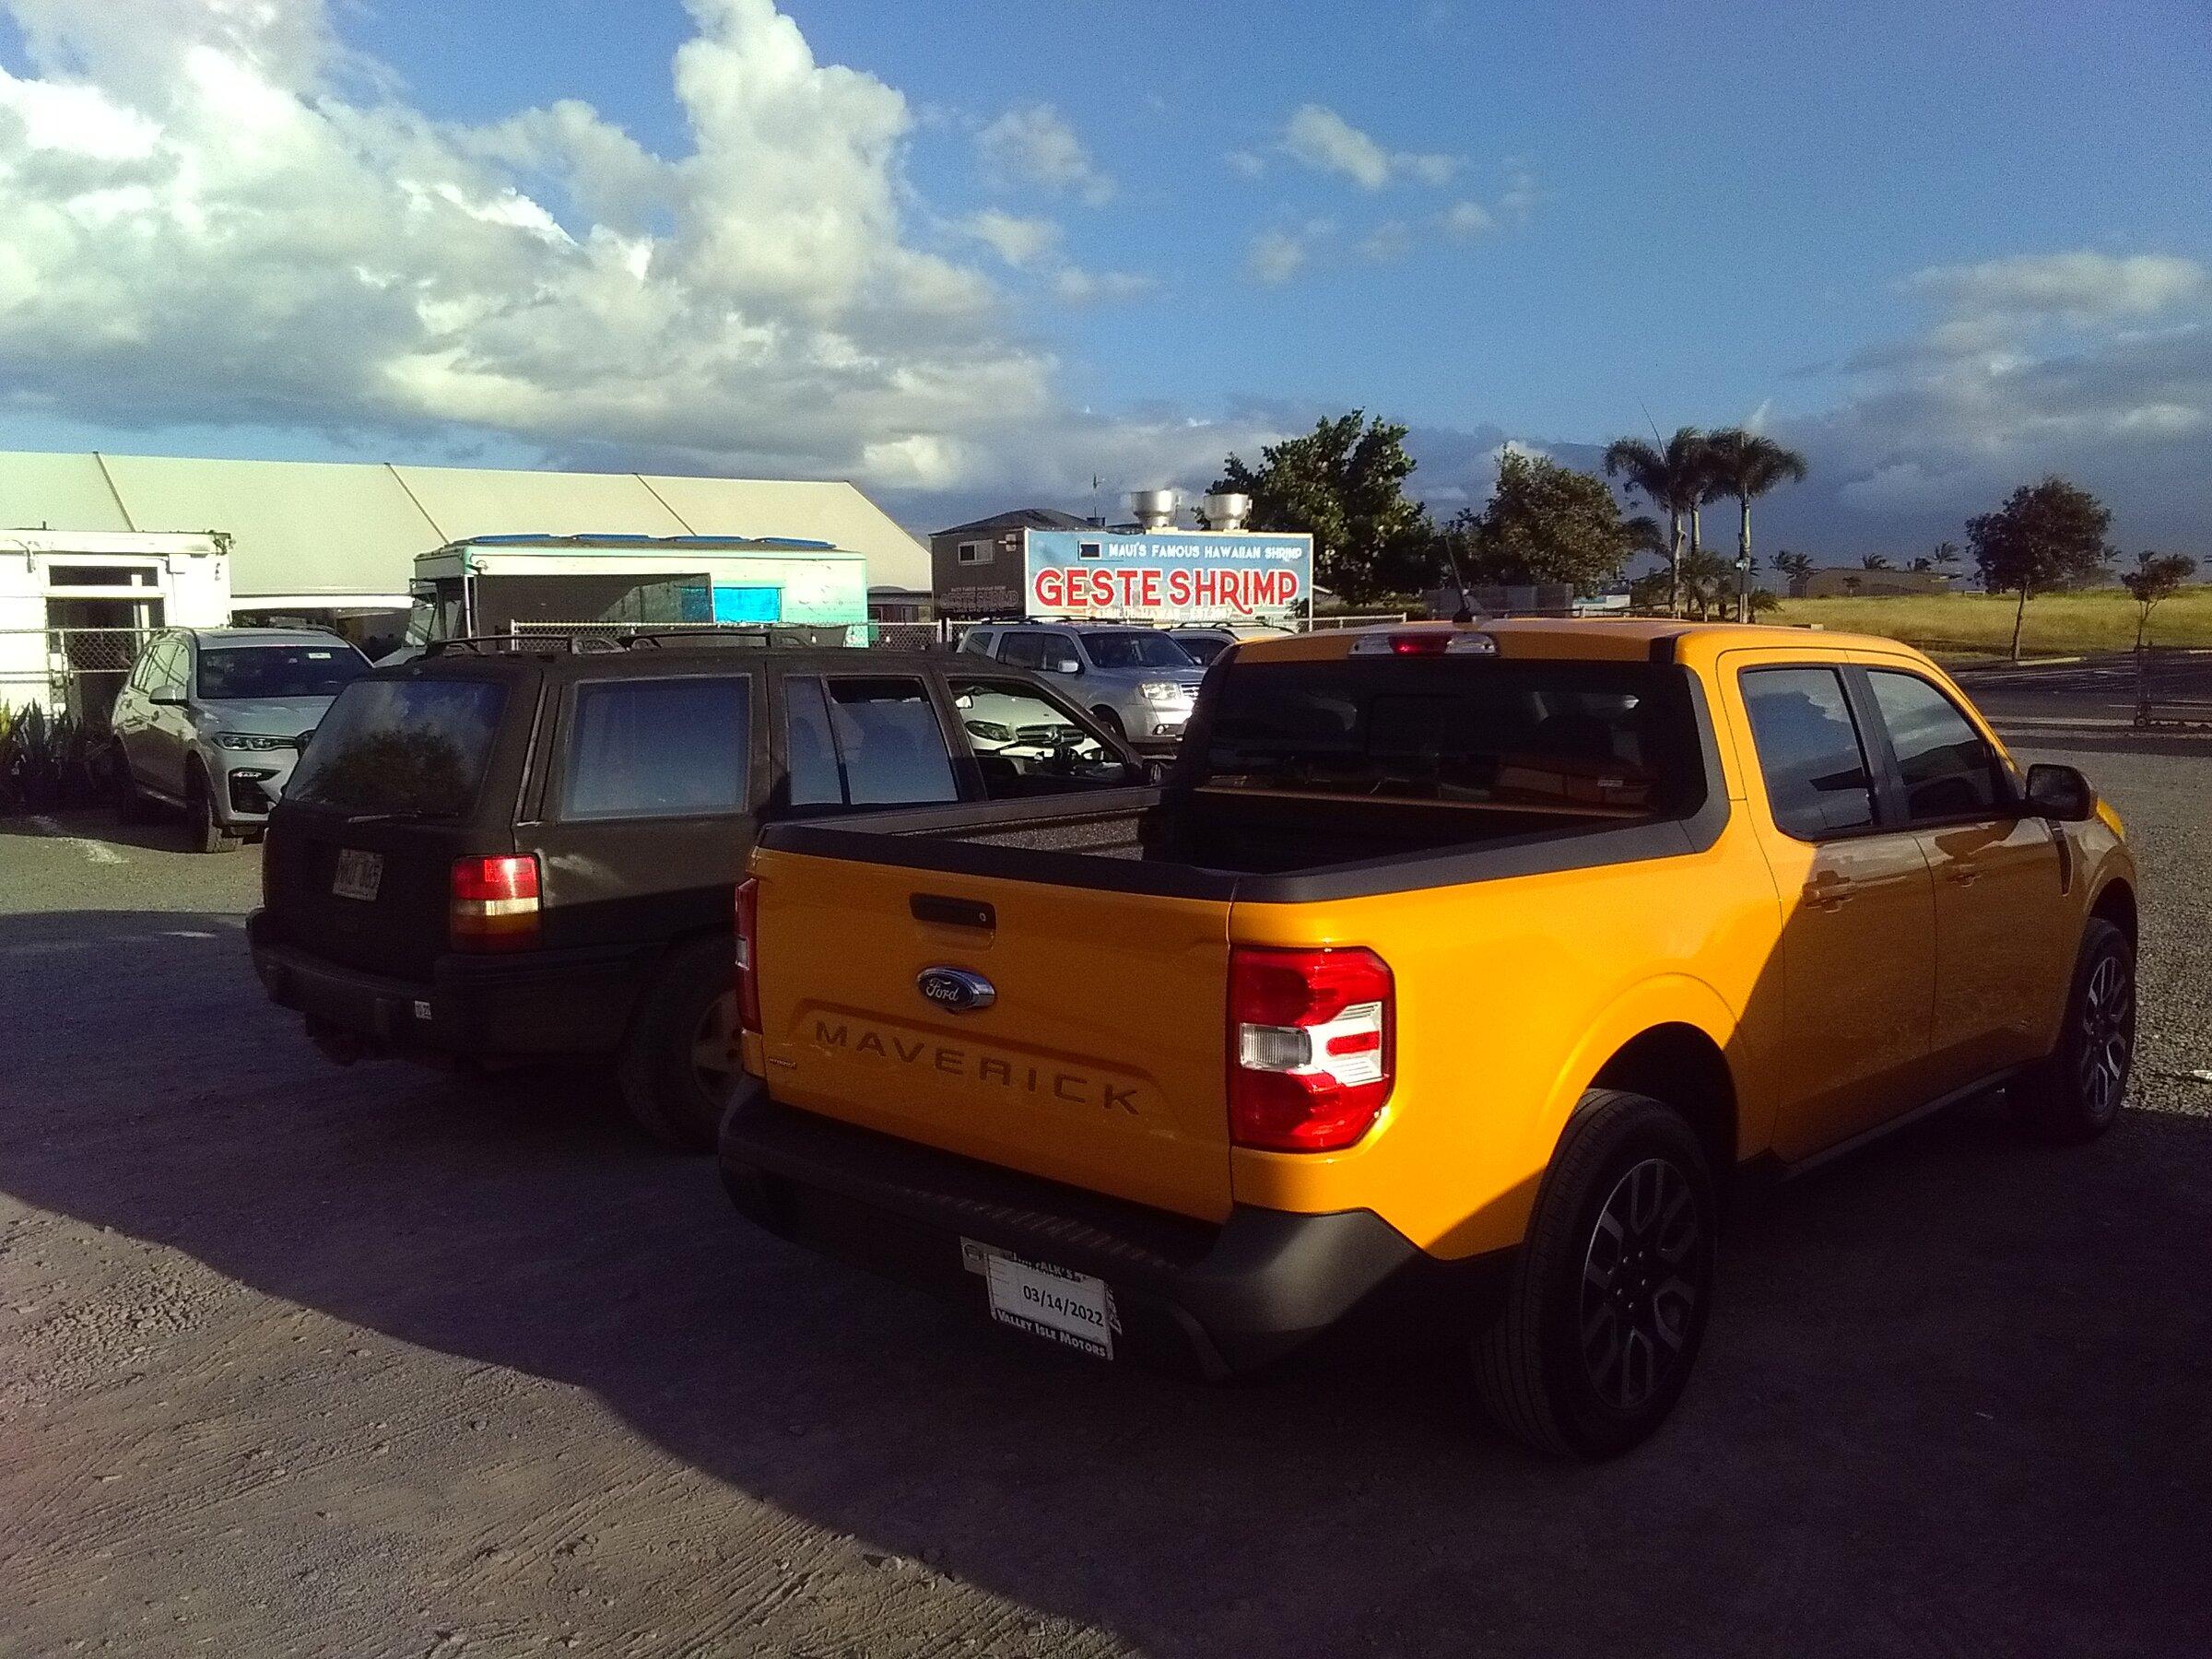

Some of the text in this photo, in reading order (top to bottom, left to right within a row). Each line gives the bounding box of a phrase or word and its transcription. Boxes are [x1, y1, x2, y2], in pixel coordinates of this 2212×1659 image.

[1108, 541, 1147, 558] MAUI'S
[1151, 543, 1199, 559] FAMOUS
[1204, 545, 1261, 559] HAWAIIAN
[1033, 568, 1300, 615] GESTE SHRIMP
[925, 978, 959, 1004] Ford
[815, 1020, 1140, 1116] MAVERICK
[1022, 1285, 1104, 1327] 03/14/2022
[1060, 1334, 1106, 1358] MOTORS
